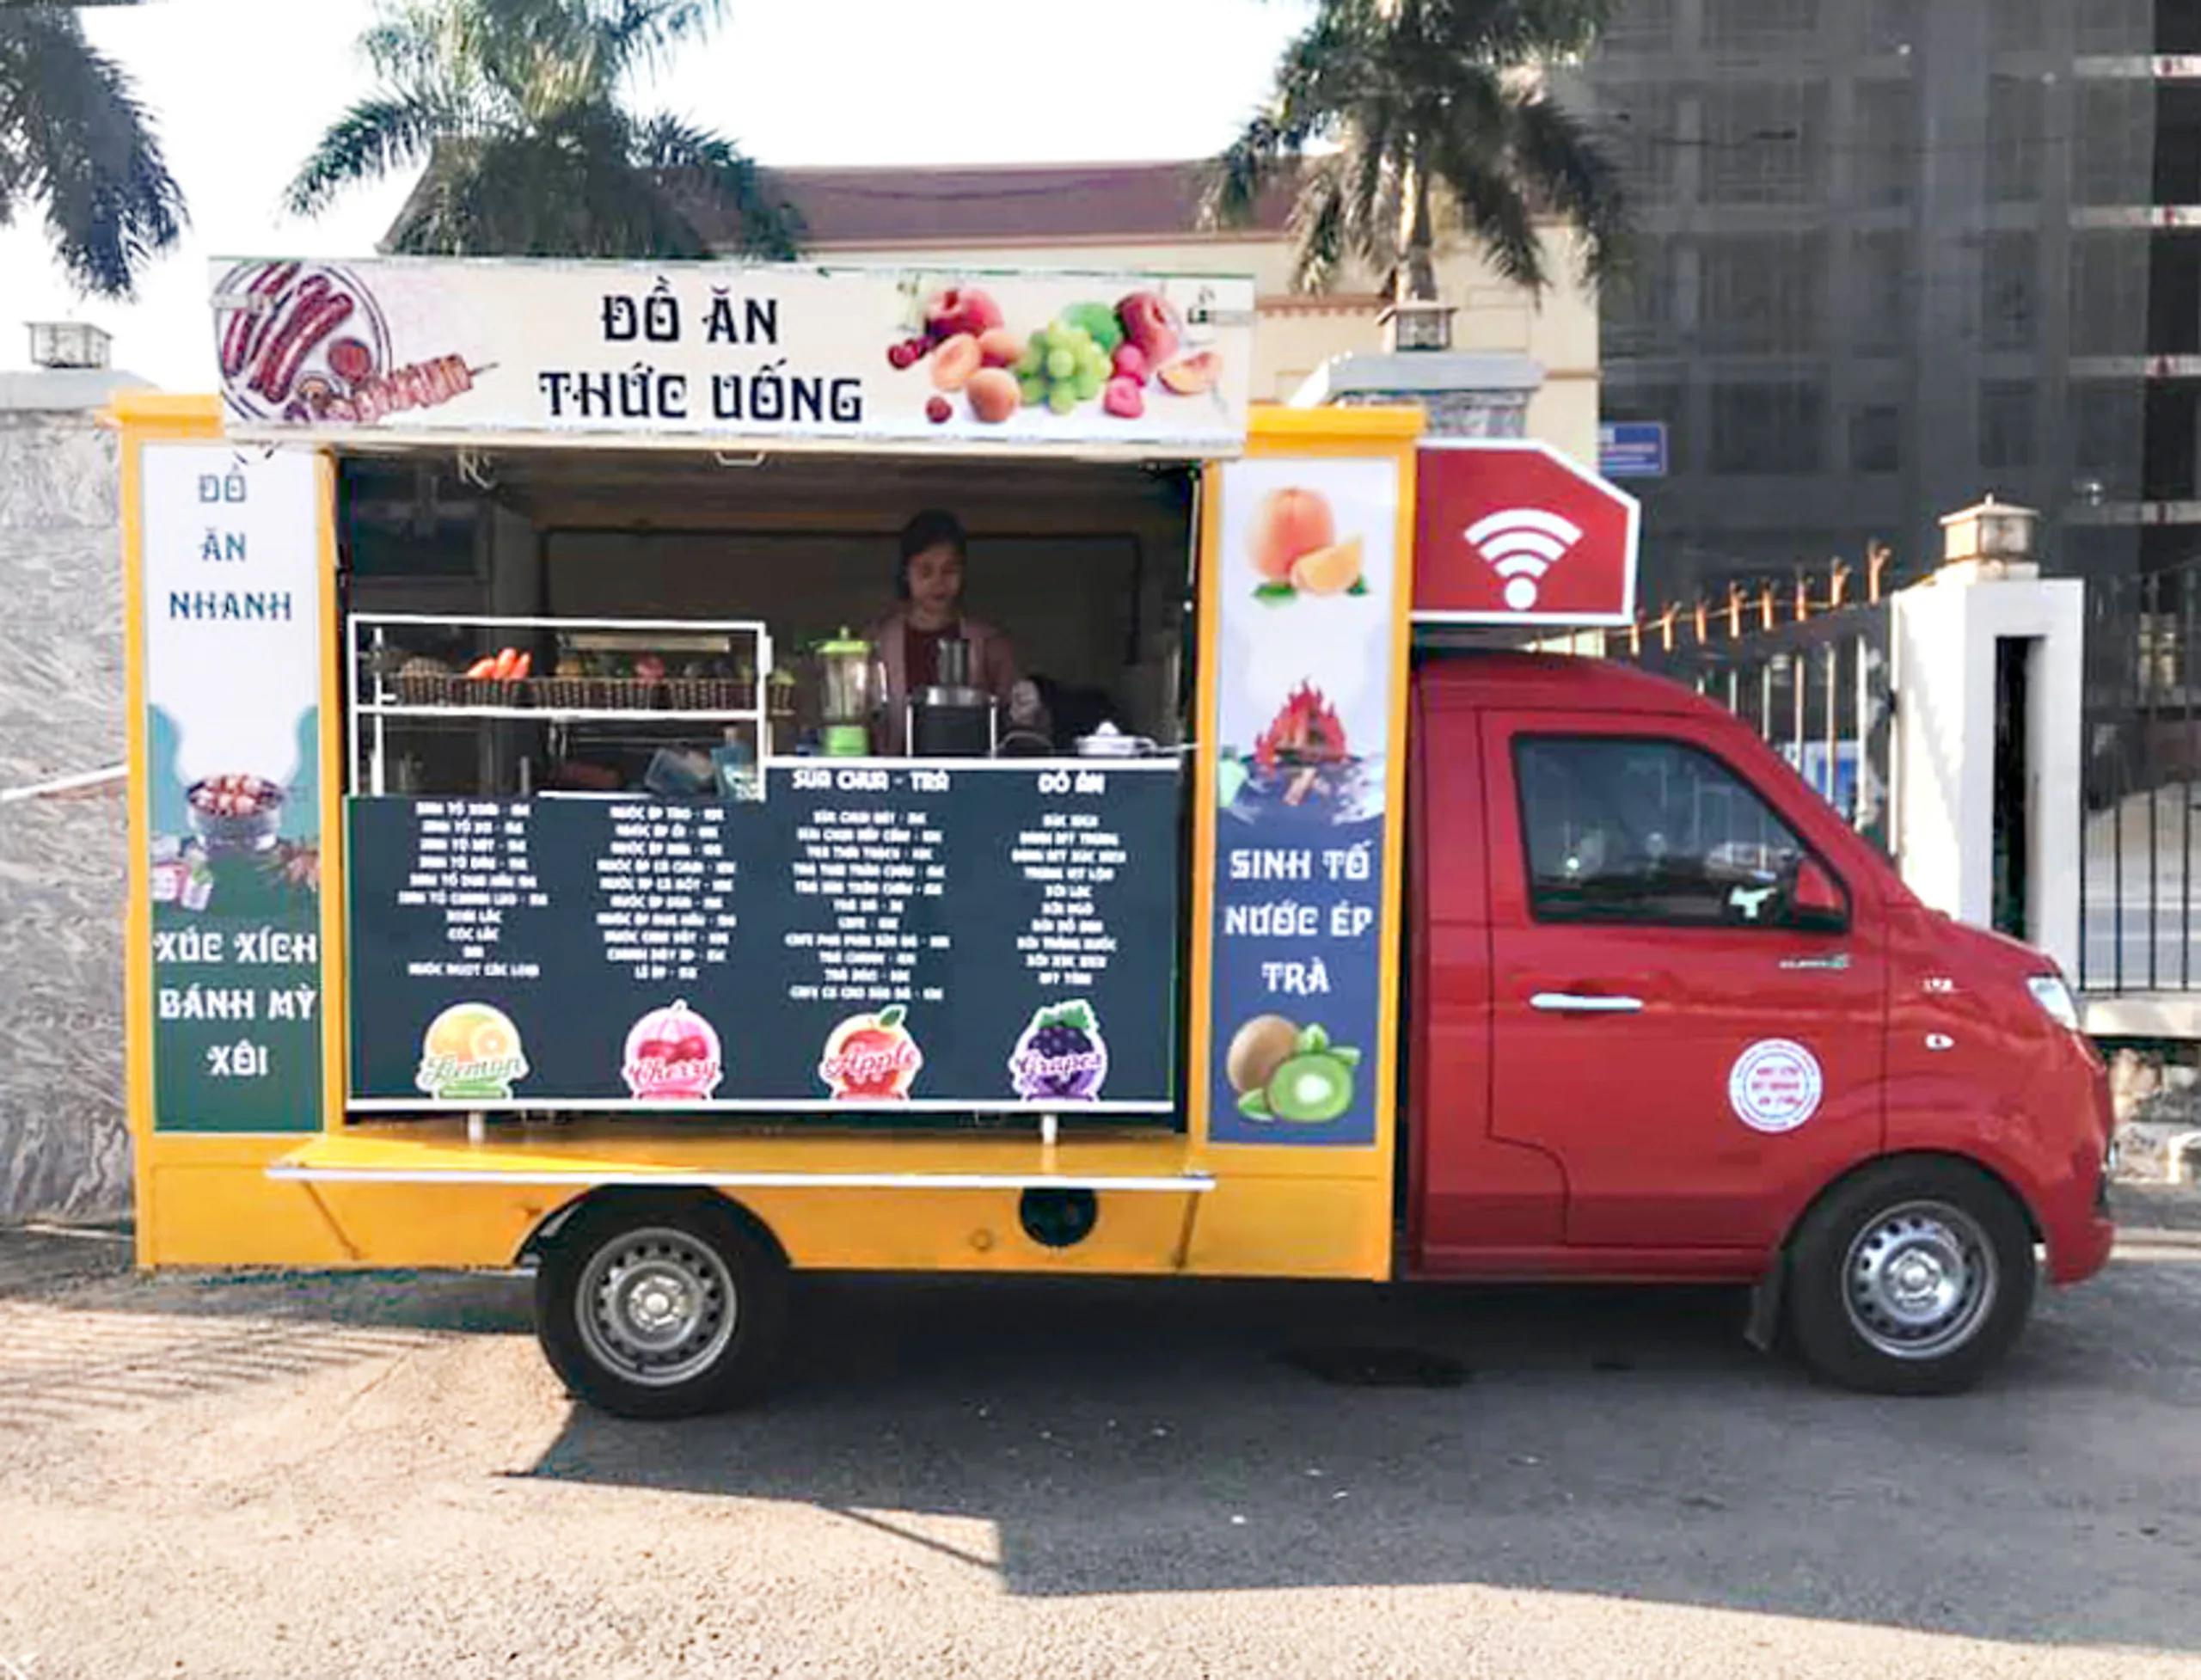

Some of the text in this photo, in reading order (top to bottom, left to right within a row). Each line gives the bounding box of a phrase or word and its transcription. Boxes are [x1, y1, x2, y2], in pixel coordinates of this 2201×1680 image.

[601, 275, 778, 345] ĐỒ ĂN
[539, 358, 862, 423] THỨC UỐNG
[169, 591, 291, 621] NHANH
[1229, 839, 1374, 880] SINH TỐ
[1224, 898, 1374, 937] NƯỚC ÉP
[153, 924, 317, 963] XÚC XÍCH
[1261, 956, 1331, 996] TRÀ
[159, 983, 317, 1021] BÁNH MỲ
[206, 1038, 269, 1076] XÔI
